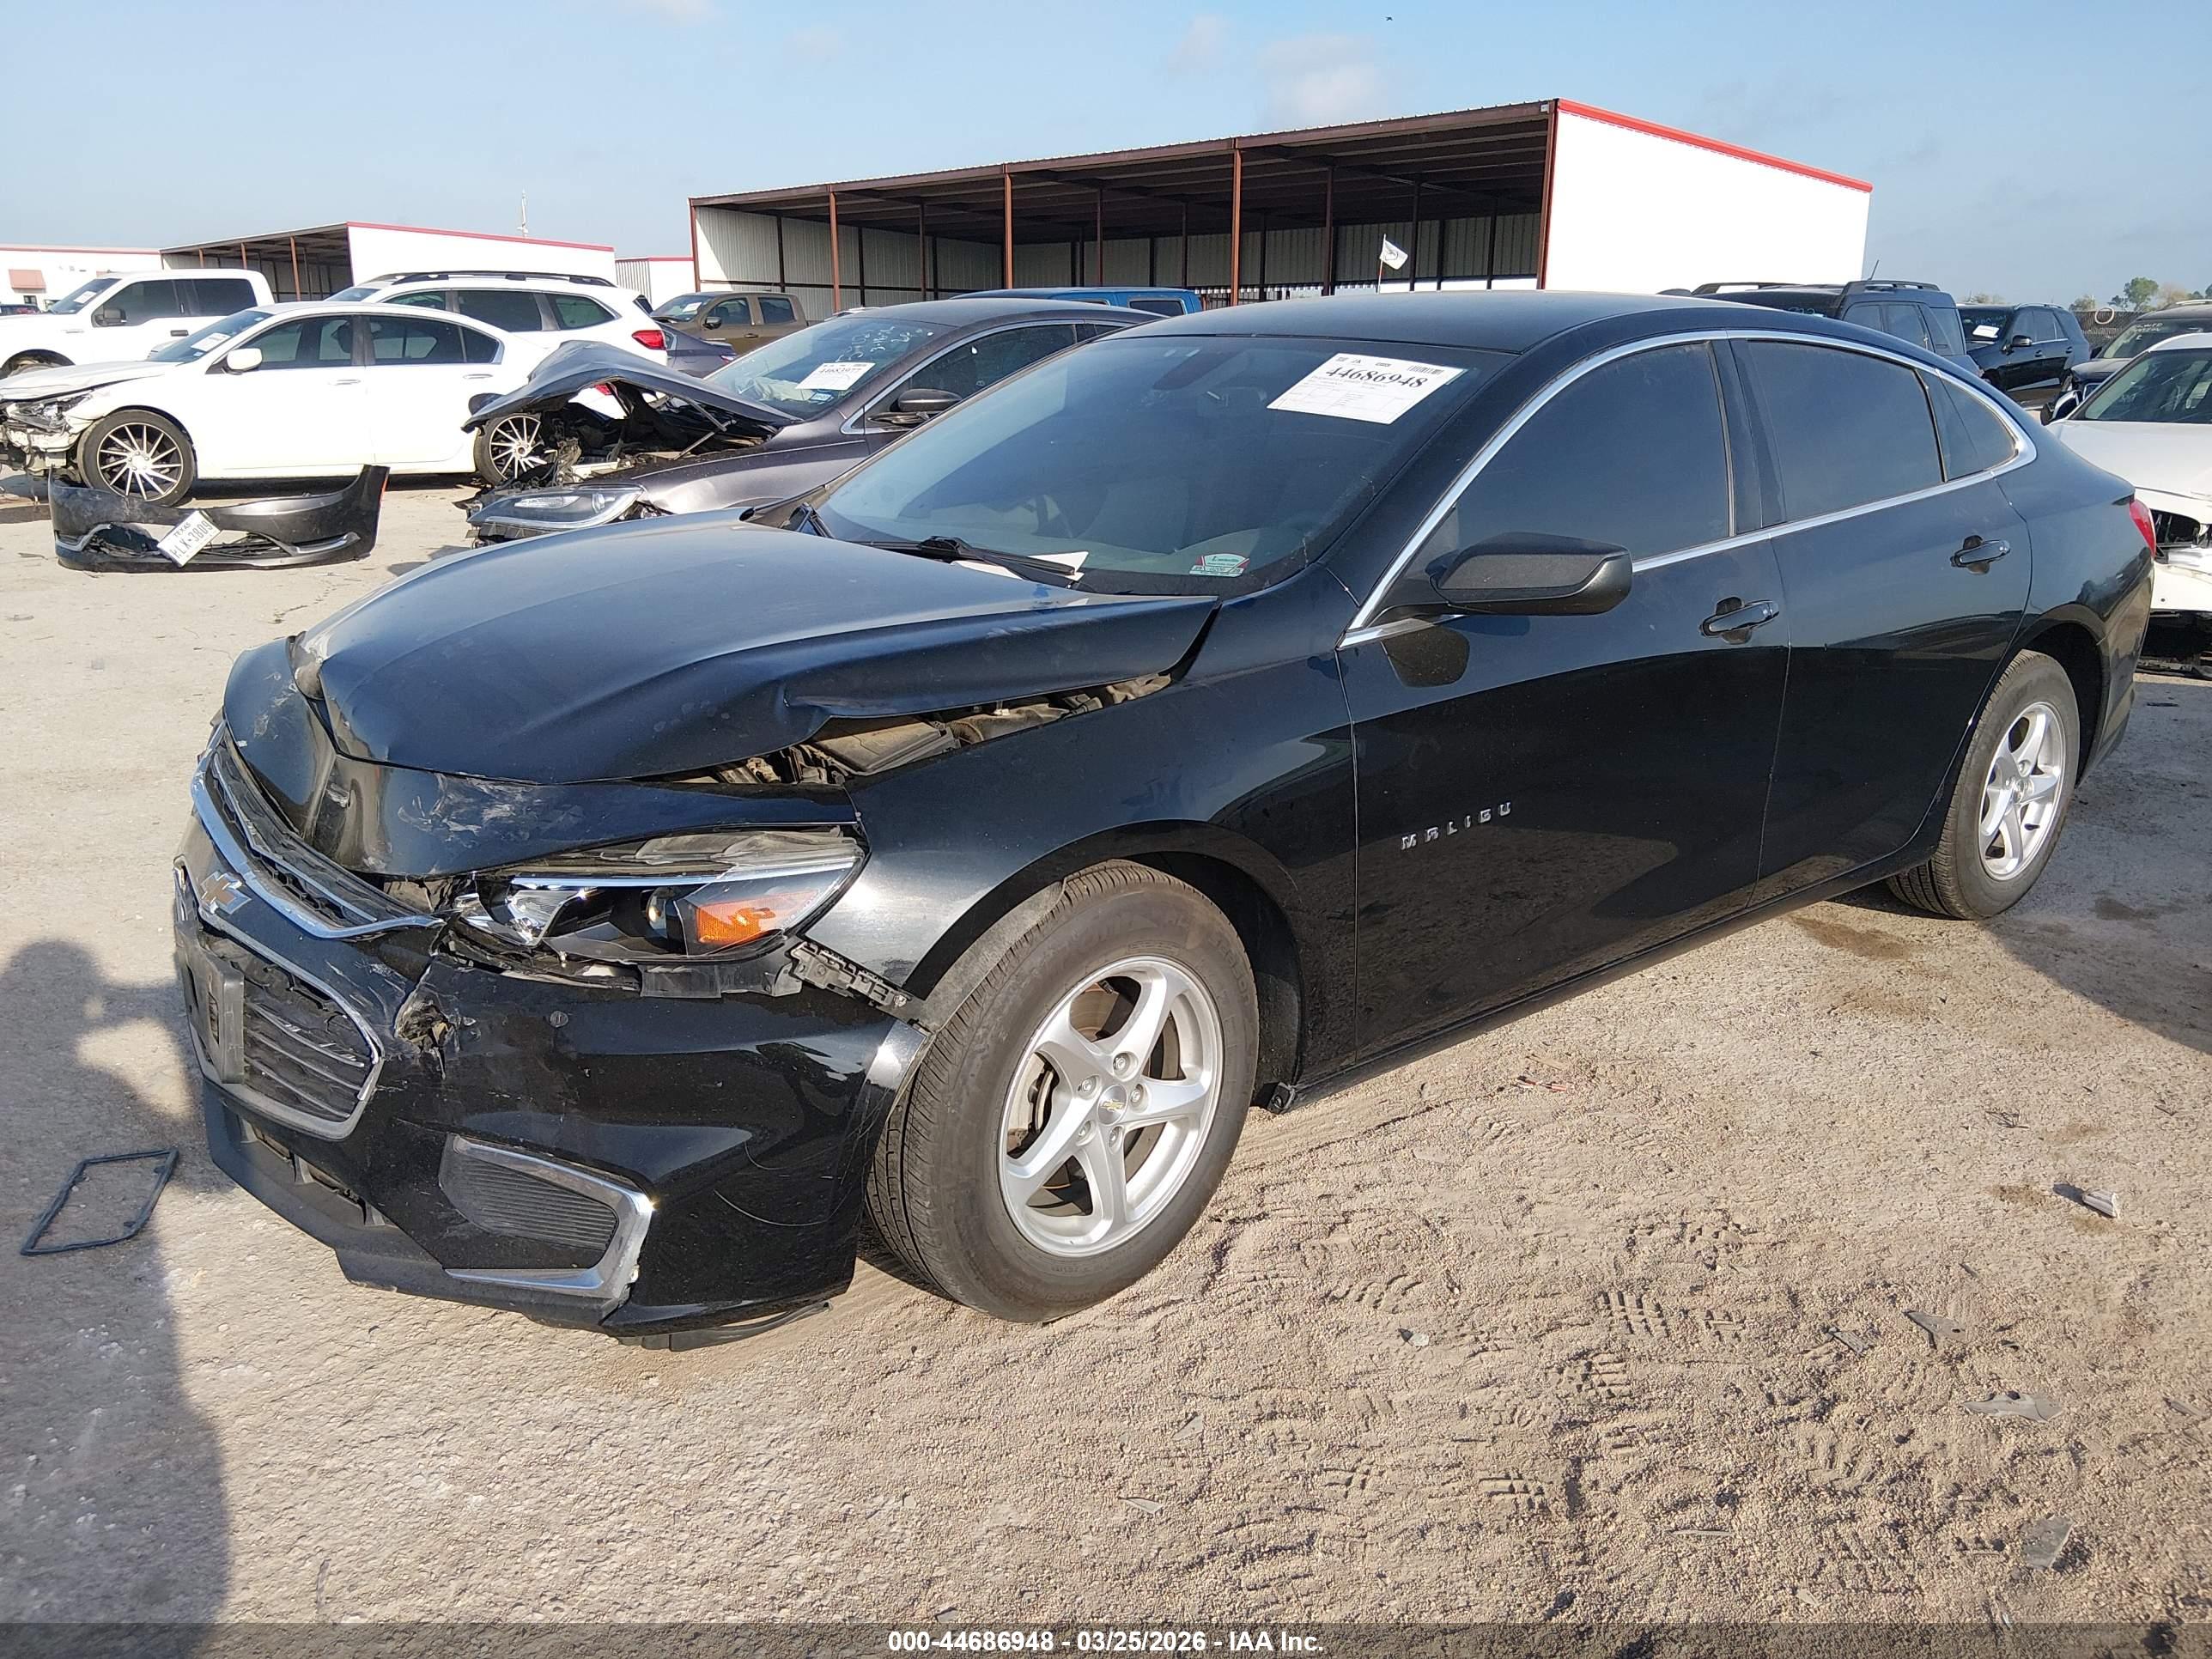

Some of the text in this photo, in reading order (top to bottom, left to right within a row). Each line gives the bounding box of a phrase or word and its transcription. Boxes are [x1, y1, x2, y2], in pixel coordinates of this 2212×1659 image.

[1326, 367, 1428, 388] 44686948
[173, 521, 191, 538] TEXAS
[1401, 801, 1511, 851] MALIBU
